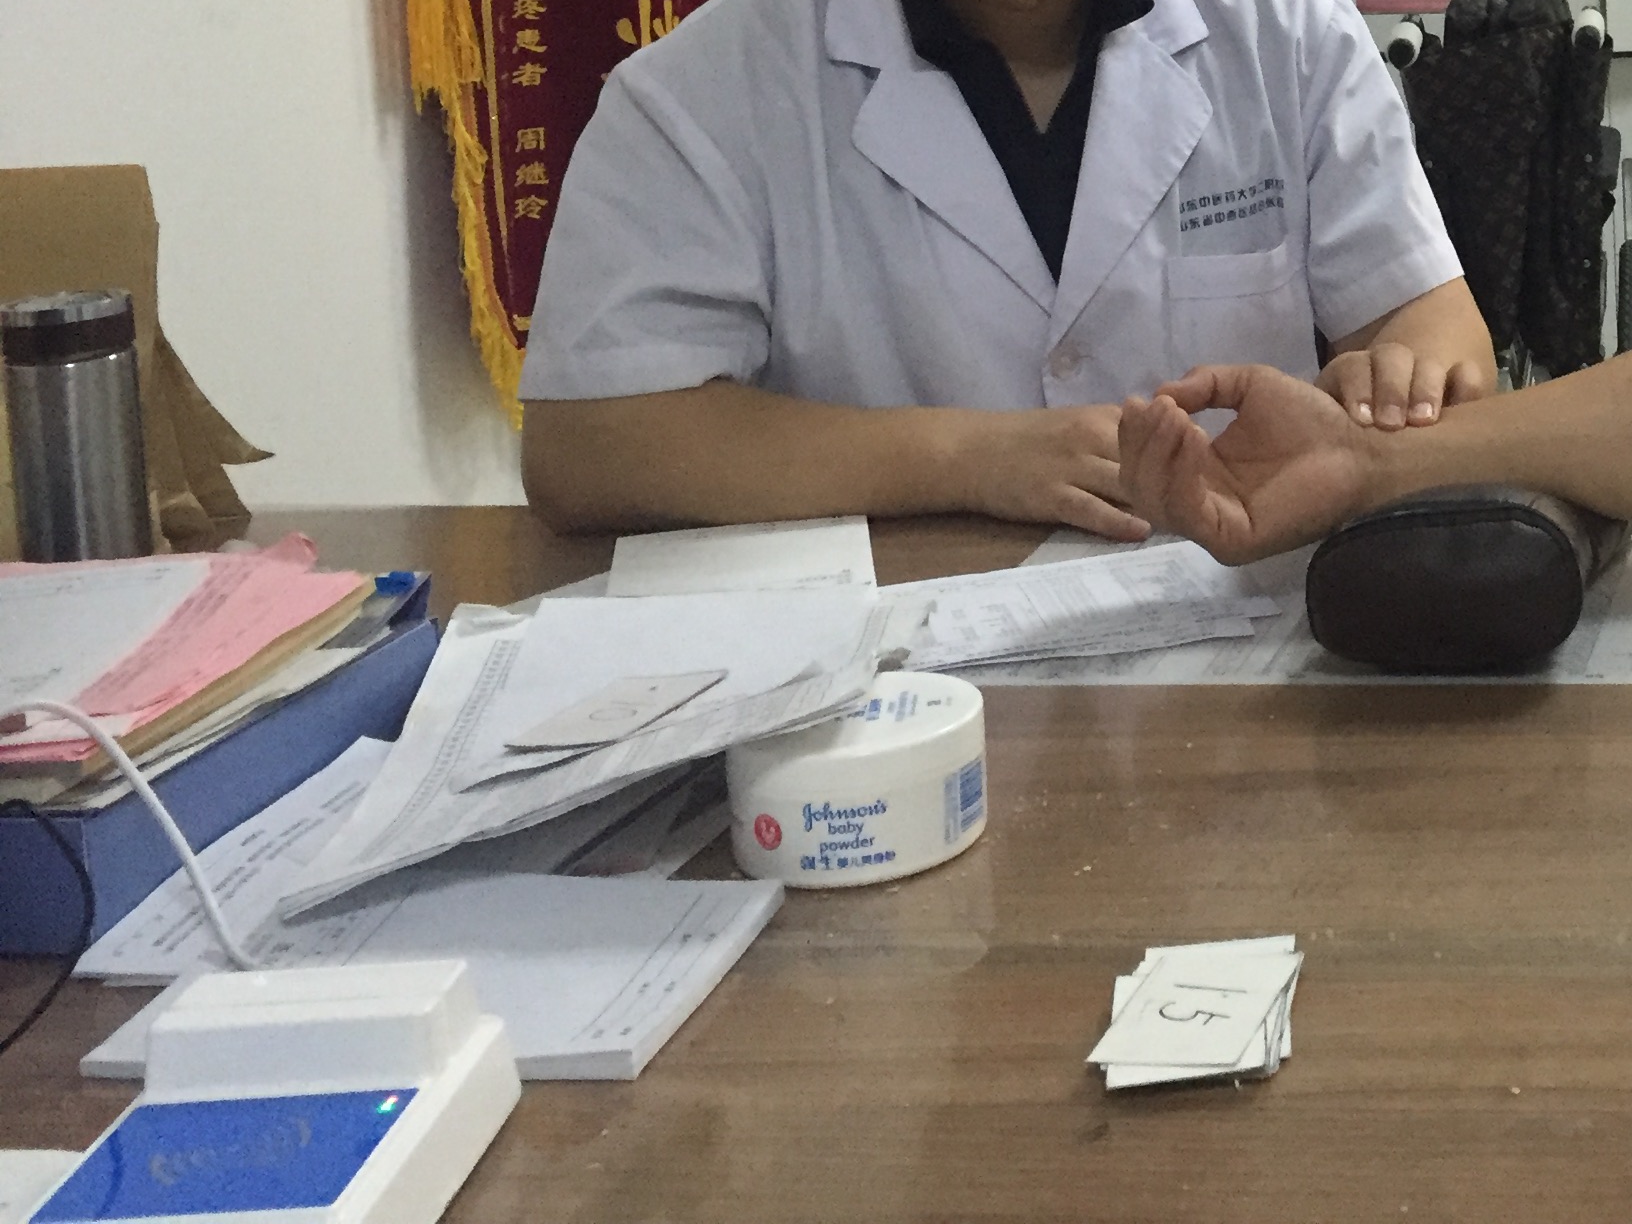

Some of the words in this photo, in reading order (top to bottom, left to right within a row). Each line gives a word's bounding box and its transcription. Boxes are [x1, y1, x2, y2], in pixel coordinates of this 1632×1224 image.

[802, 800, 887, 833] Johnson's
[827, 821, 864, 837] baby
[819, 836, 875, 855] powder
